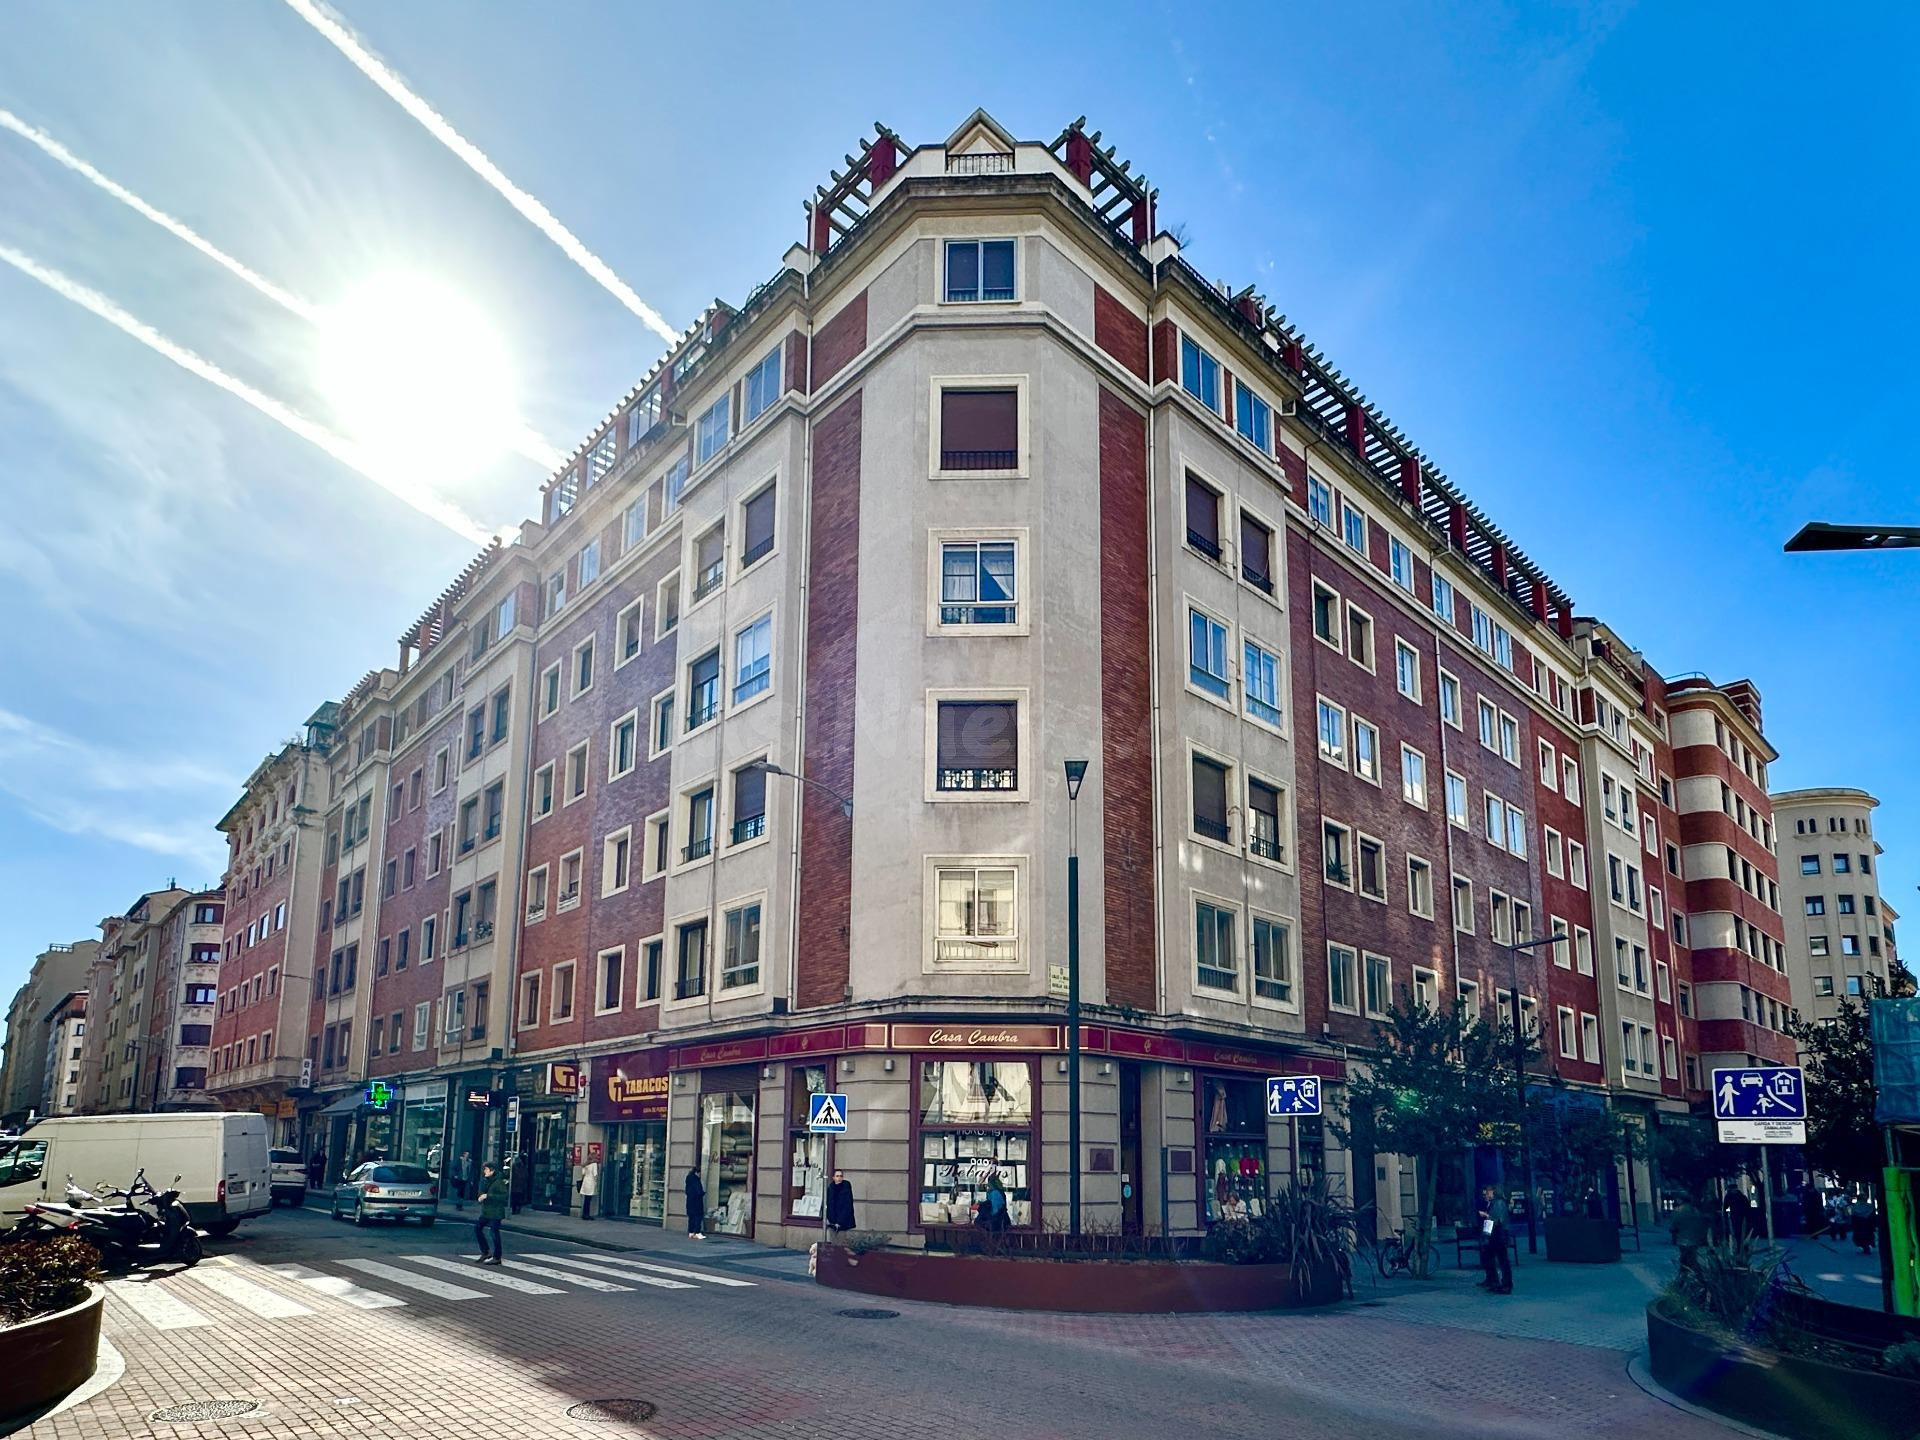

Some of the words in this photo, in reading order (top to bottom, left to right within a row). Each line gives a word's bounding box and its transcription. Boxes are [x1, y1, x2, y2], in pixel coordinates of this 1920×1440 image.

[928, 1029, 963, 1045] Casa
[967, 1029, 1019, 1045] Cambra
[302, 1061, 311, 1086] BAR
[626, 1076, 669, 1094] TABACOS
